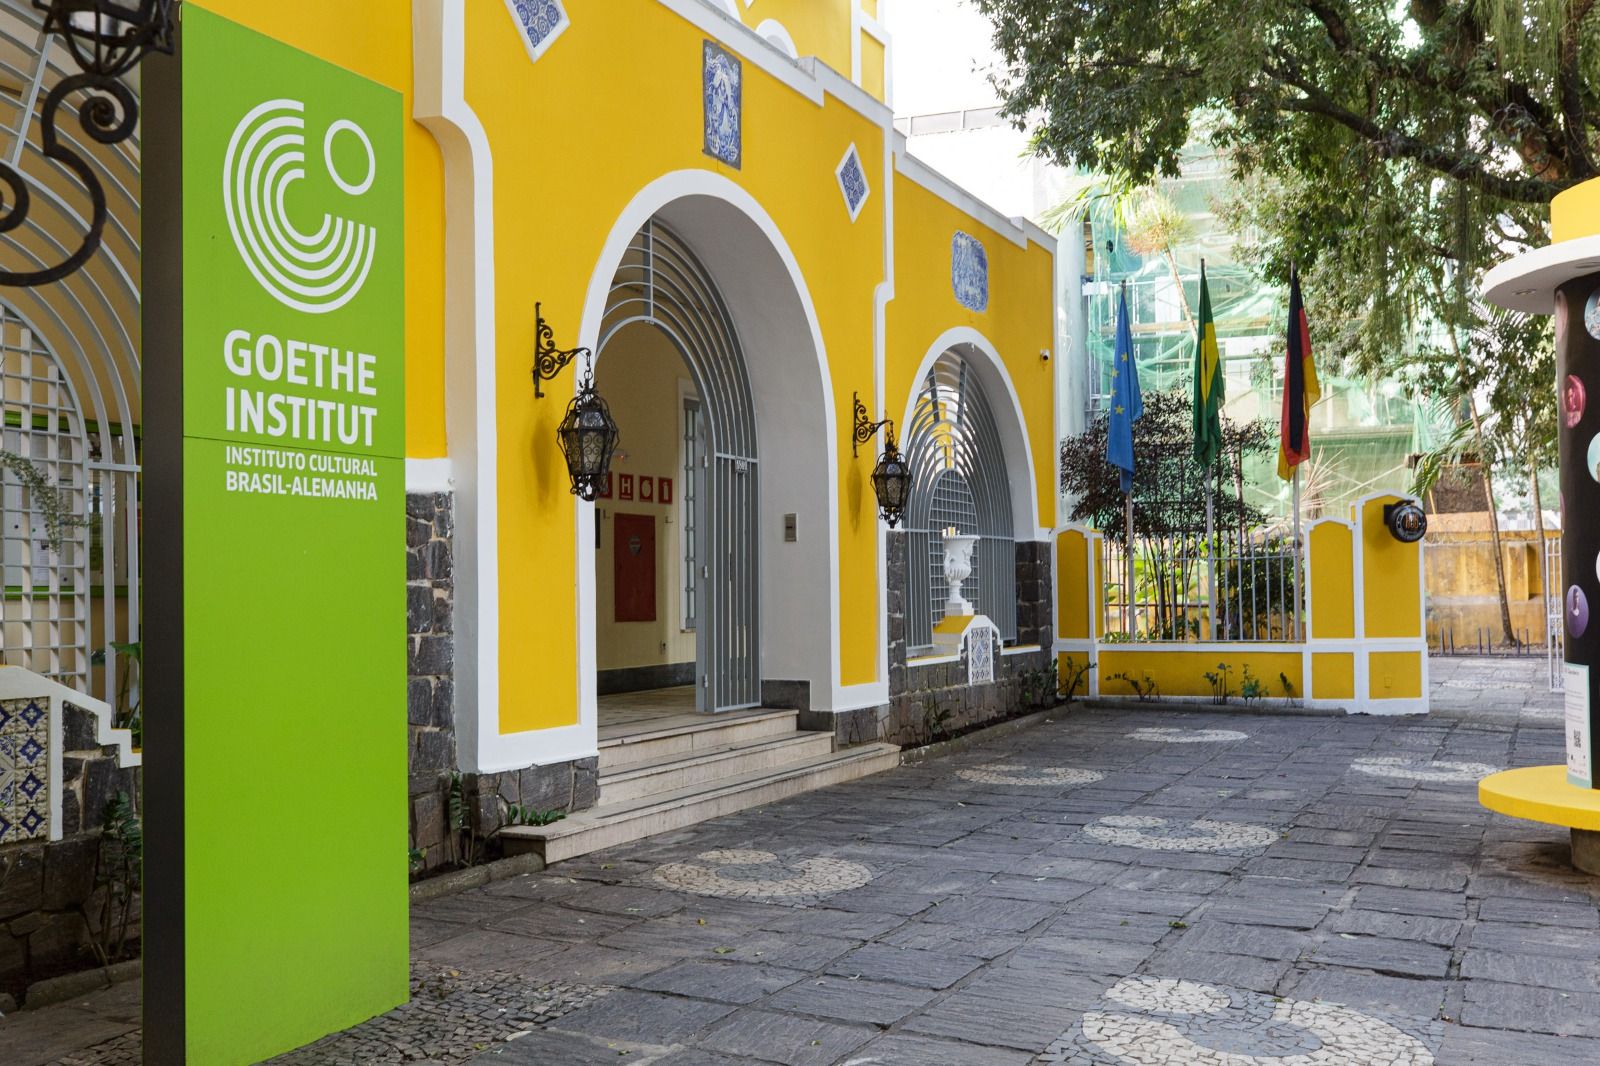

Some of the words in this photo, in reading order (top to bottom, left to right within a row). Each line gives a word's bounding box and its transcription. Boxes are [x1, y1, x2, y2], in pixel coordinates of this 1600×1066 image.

[223, 329, 377, 396] GOETHE
[226, 387, 378, 447] INSTITUT
[226, 446, 306, 471] INSTITUTO
[309, 454, 378, 477] CULTURAL
[226, 470, 378, 501] BRASIL-ALEMANHA
[621, 477, 631, 494] H
